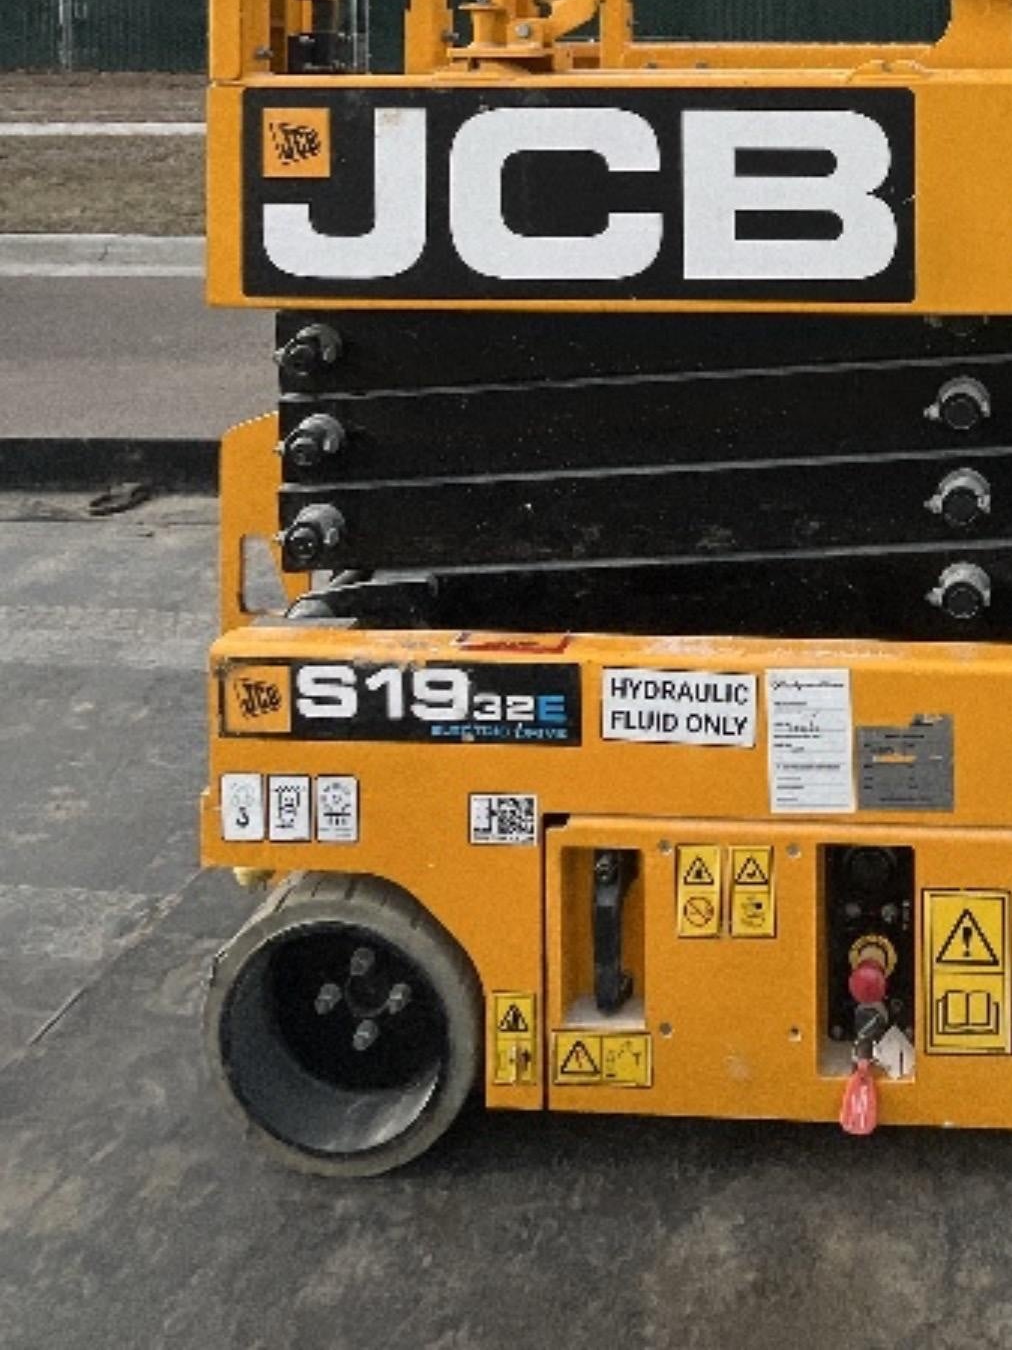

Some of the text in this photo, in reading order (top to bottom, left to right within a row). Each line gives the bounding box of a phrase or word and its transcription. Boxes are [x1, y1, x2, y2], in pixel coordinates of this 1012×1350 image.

[262, 106, 898, 280] JCB
[611, 677, 748, 706] HYDRAULIC
[611, 710, 679, 733] FLUID
[686, 713, 748, 737] ONLY
